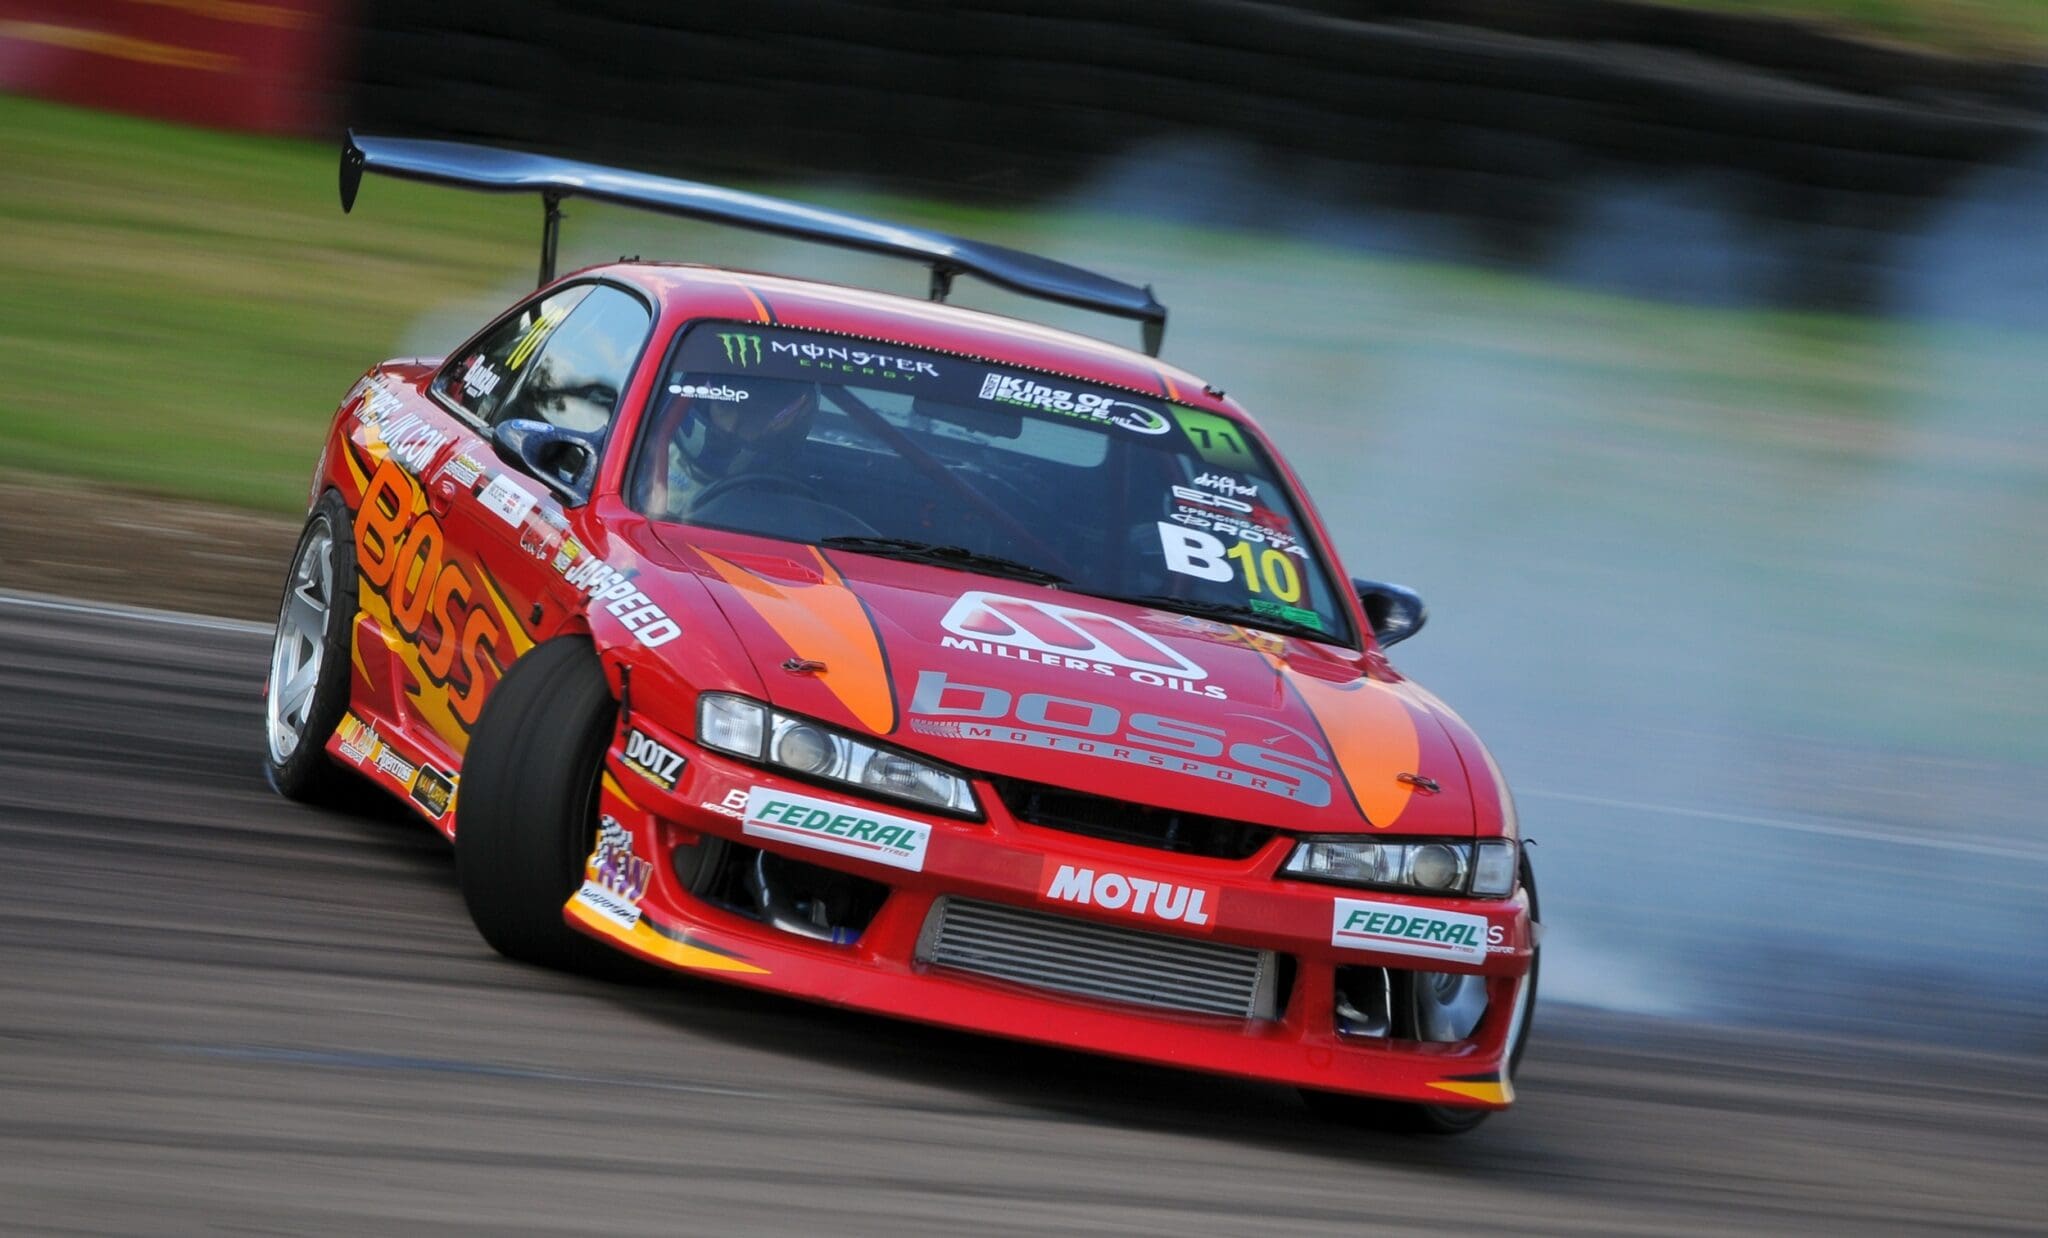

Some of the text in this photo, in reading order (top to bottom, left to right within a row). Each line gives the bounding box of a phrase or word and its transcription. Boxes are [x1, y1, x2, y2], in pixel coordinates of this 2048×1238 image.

[771, 341, 940, 377] MONSTER
[800, 359, 916, 381] ENERGY
[710, 385, 749, 402] obp
[995, 389, 1110, 419] EUROPE
[1000, 376, 1073, 401] King
[1194, 472, 1258, 498] drifted
[1213, 521, 1310, 559] ROTA
[353, 458, 500, 727] BOSS
[564, 555, 682, 648] JAPSPEED
[941, 636, 1228, 701] MILLERS OILS
[626, 729, 686, 783] DOTZ
[970, 726, 1300, 799] MOTORSPORT
[756, 800, 917, 851] FEDERAL
[1046, 865, 1209, 926] MOTUL
[1343, 910, 1480, 947] FEDERAL
